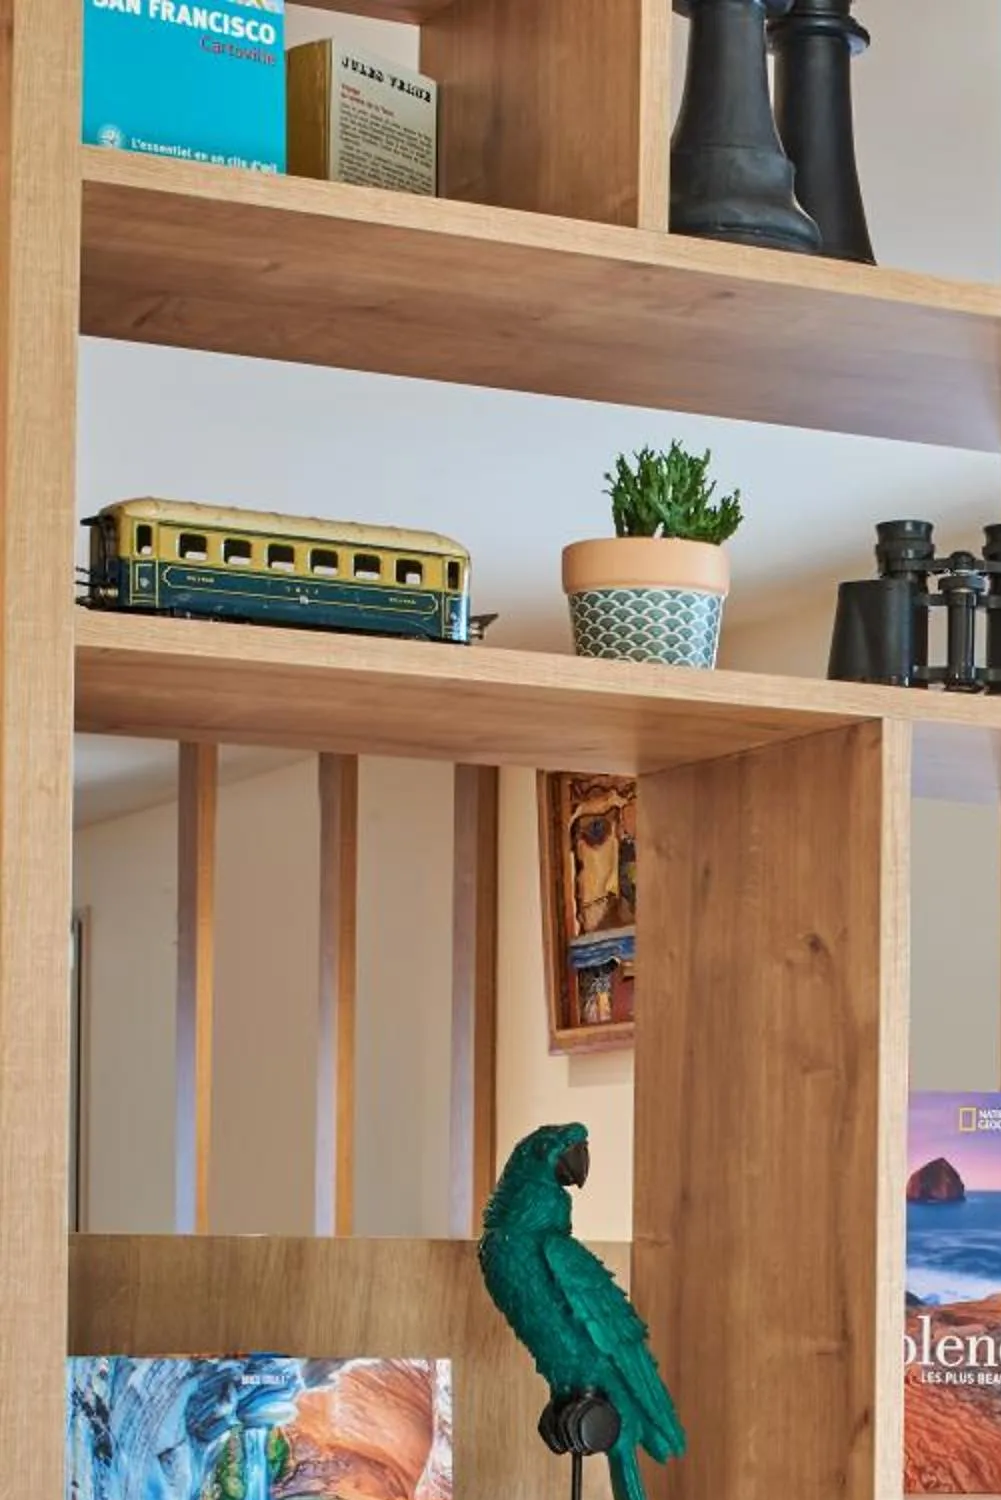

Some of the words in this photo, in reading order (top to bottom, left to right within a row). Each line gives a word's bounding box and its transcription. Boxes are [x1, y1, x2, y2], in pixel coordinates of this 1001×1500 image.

[149, 0, 276, 45] FRANCISCO
[921, 1371, 943, 1383] LES
[945, 1372, 975, 1384] PLUS
